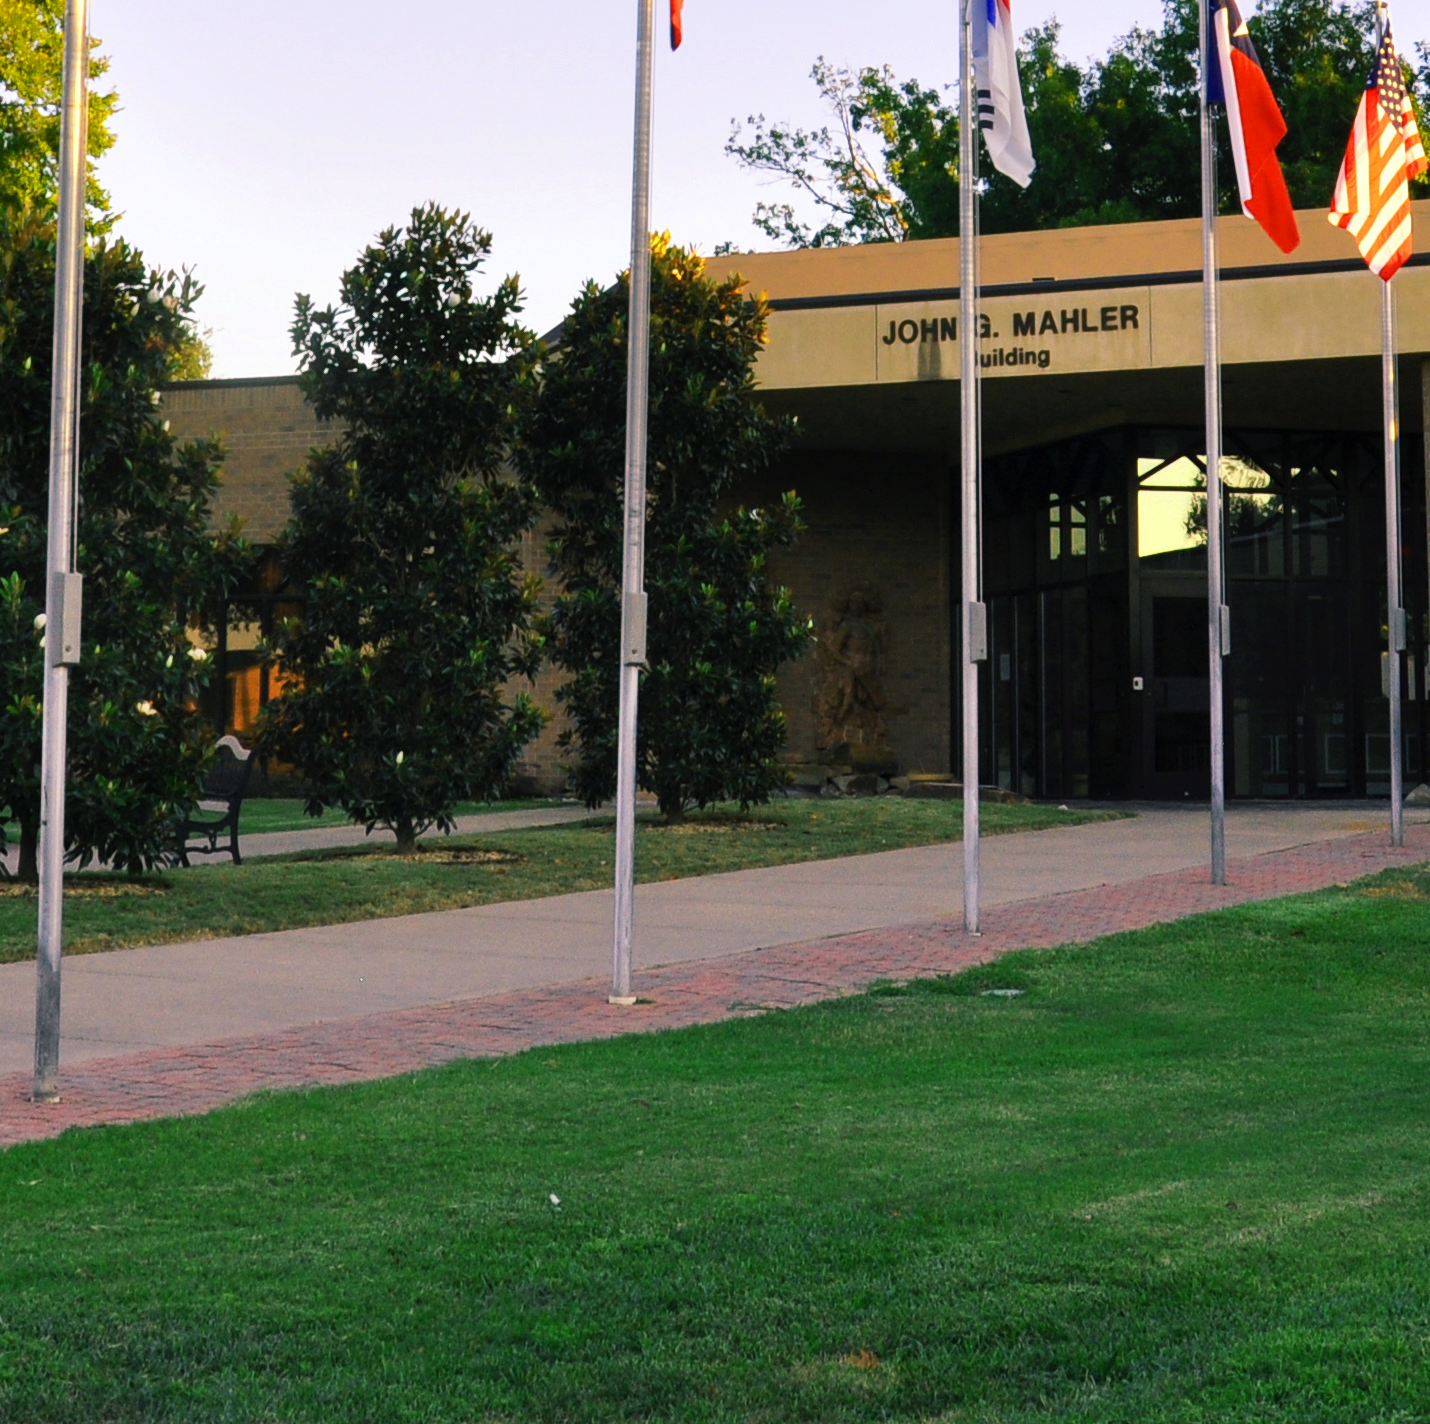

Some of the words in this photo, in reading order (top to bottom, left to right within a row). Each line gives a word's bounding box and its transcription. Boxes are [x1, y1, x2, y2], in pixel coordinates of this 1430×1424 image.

[882, 316, 957, 346] JOHN
[1012, 304, 1140, 338] MAHLER
[974, 347, 1051, 369] uilding
